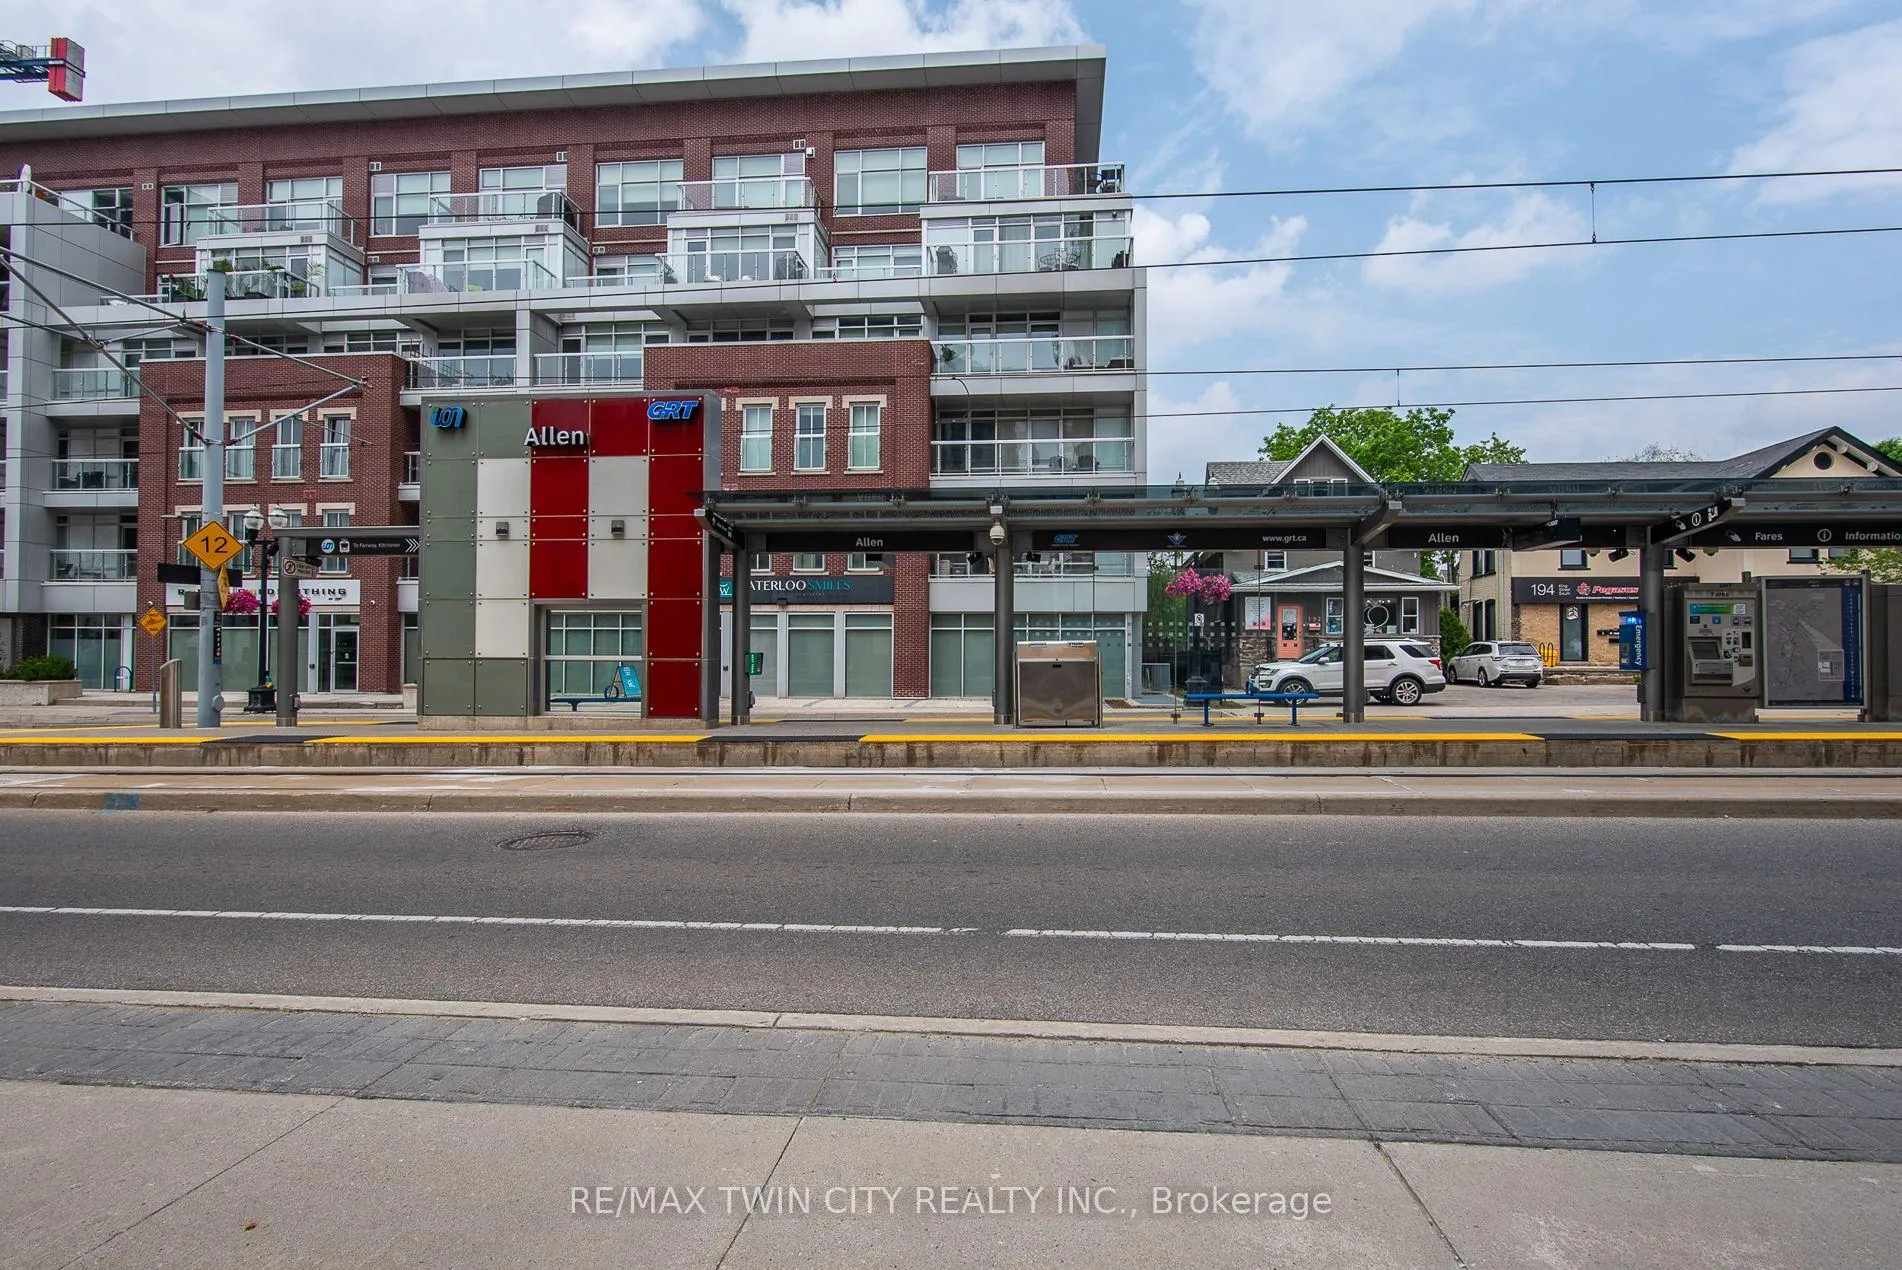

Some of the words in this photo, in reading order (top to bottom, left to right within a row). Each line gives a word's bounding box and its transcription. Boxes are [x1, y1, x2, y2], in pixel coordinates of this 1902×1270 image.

[647, 401, 698, 419] GRT
[523, 426, 584, 446] Allen
[1262, 534, 1307, 544] www.grt.ca
[1428, 533, 1460, 543] Allen
[1754, 532, 1783, 541] Fares
[1845, 531, 1902, 541] Informatio
[200, 536, 228, 554] 12
[855, 537, 884, 547] Allen
[1531, 583, 1555, 596] 194
[1592, 585, 1639, 595] Pegasus
[1634, 624, 1643, 666] Emergency
